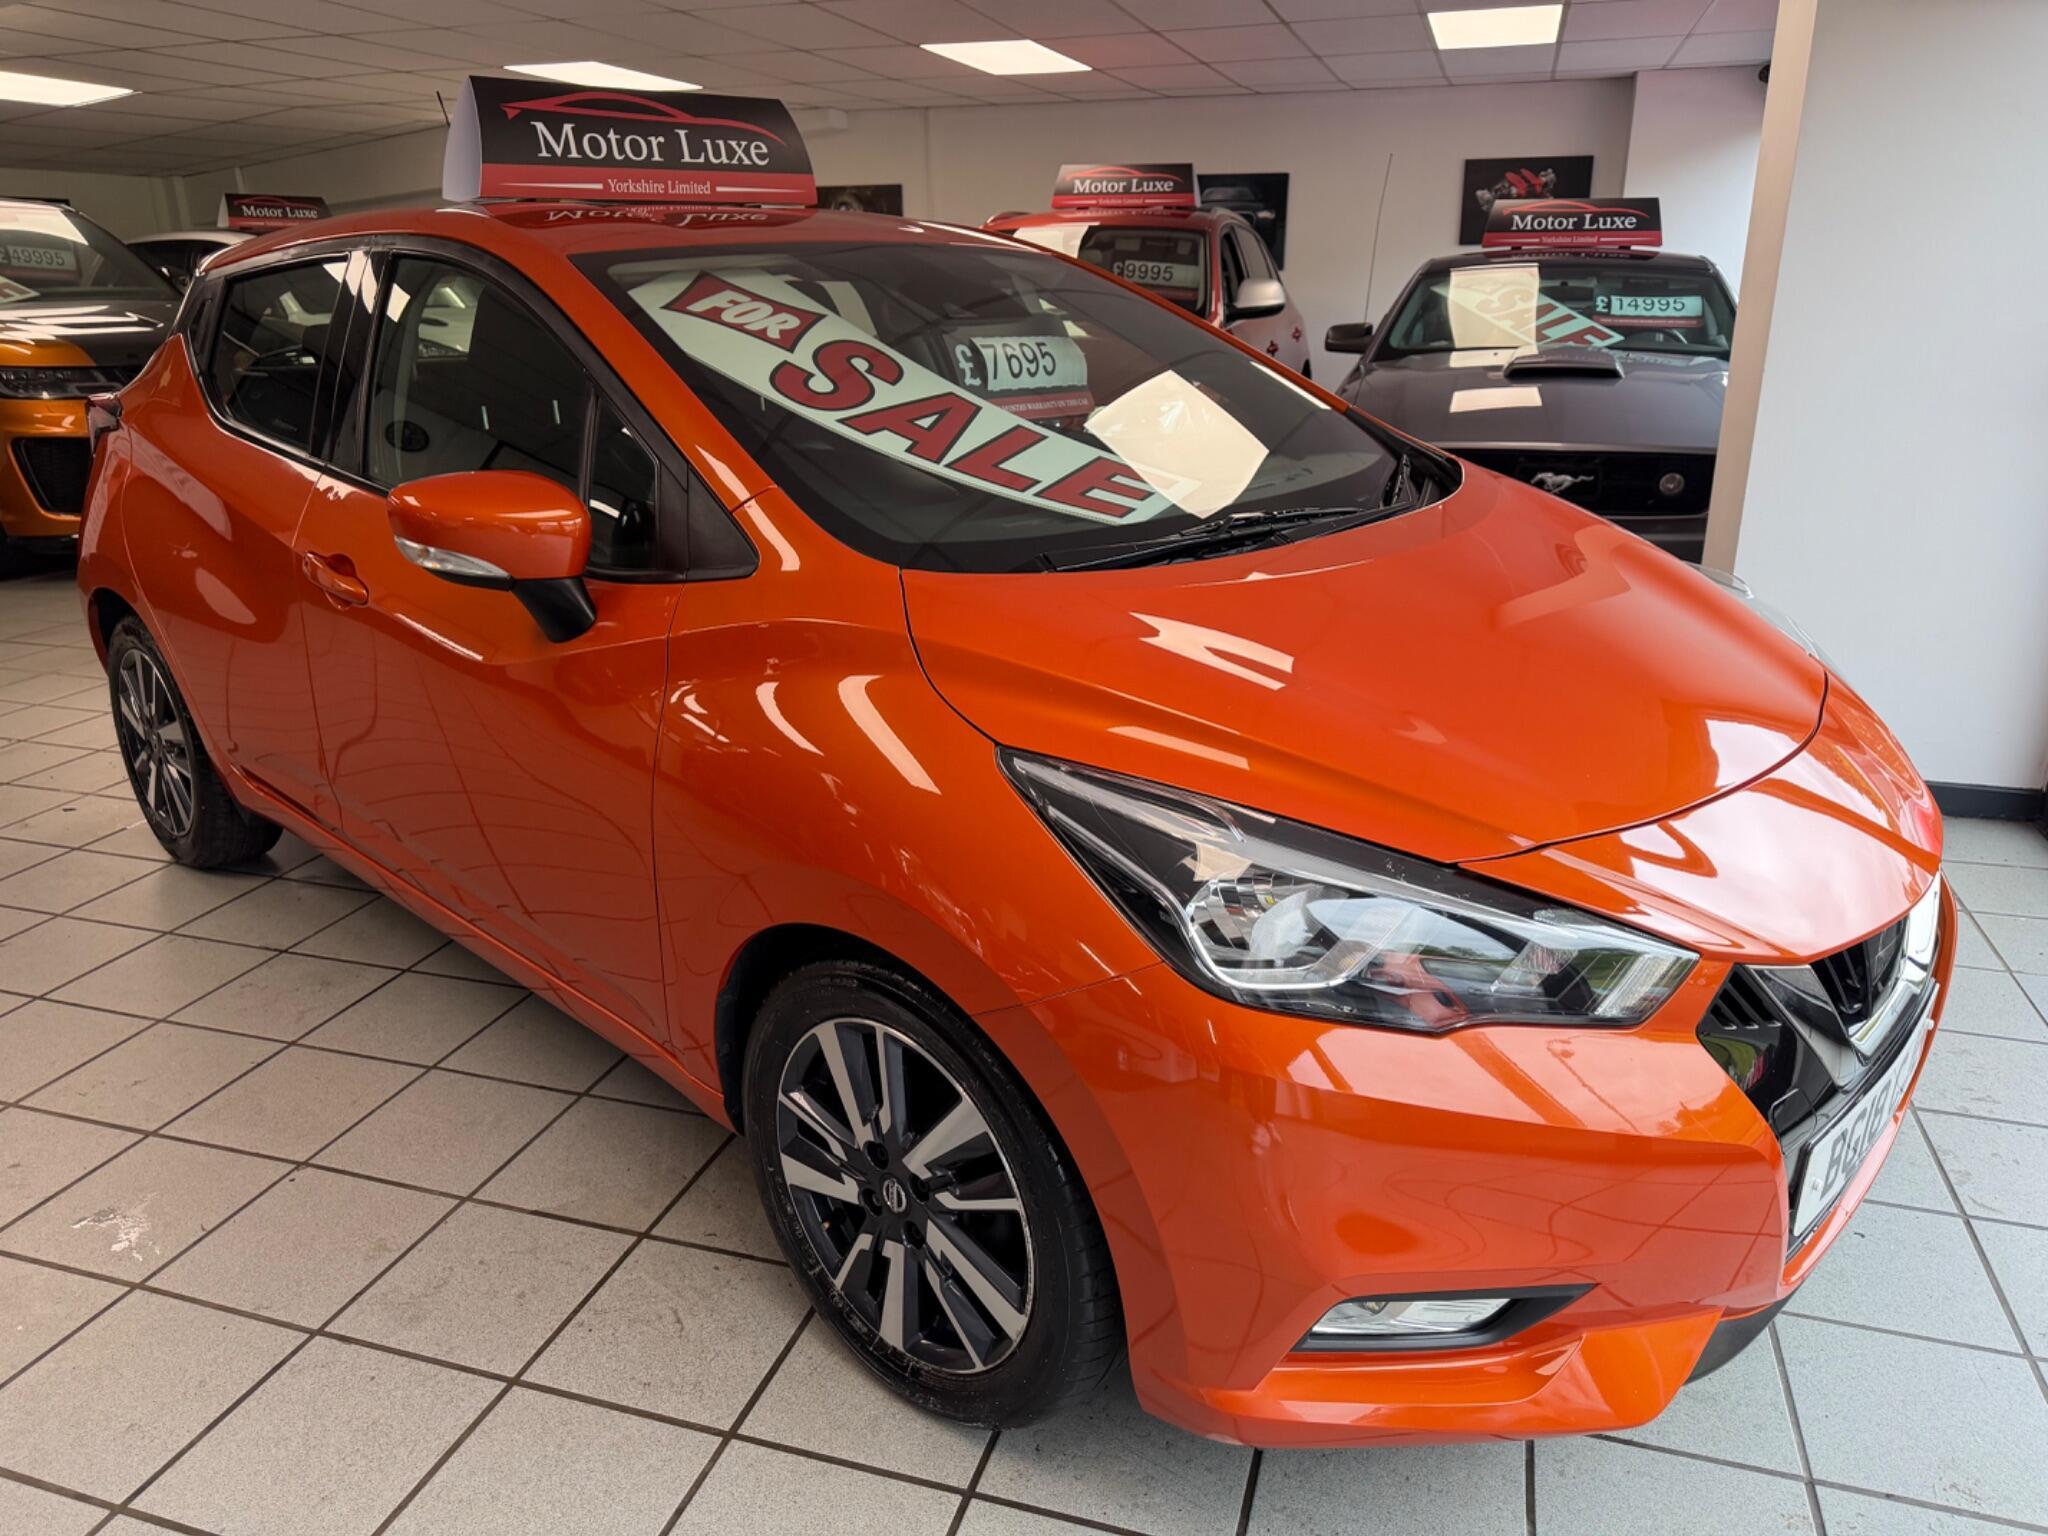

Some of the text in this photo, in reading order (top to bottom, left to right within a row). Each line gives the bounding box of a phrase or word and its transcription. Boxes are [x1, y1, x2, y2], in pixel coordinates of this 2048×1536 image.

[530, 121, 770, 165] Motor Luxe
[607, 178, 711, 195] Yorkshire Limited
[1073, 178, 1174, 194] Motor Luxe
[241, 204, 318, 218] Motor Luxe
[1510, 213, 1637, 230] Motor Luxe
[687, 290, 801, 339] FOR
[769, 339, 1153, 519] SALE
